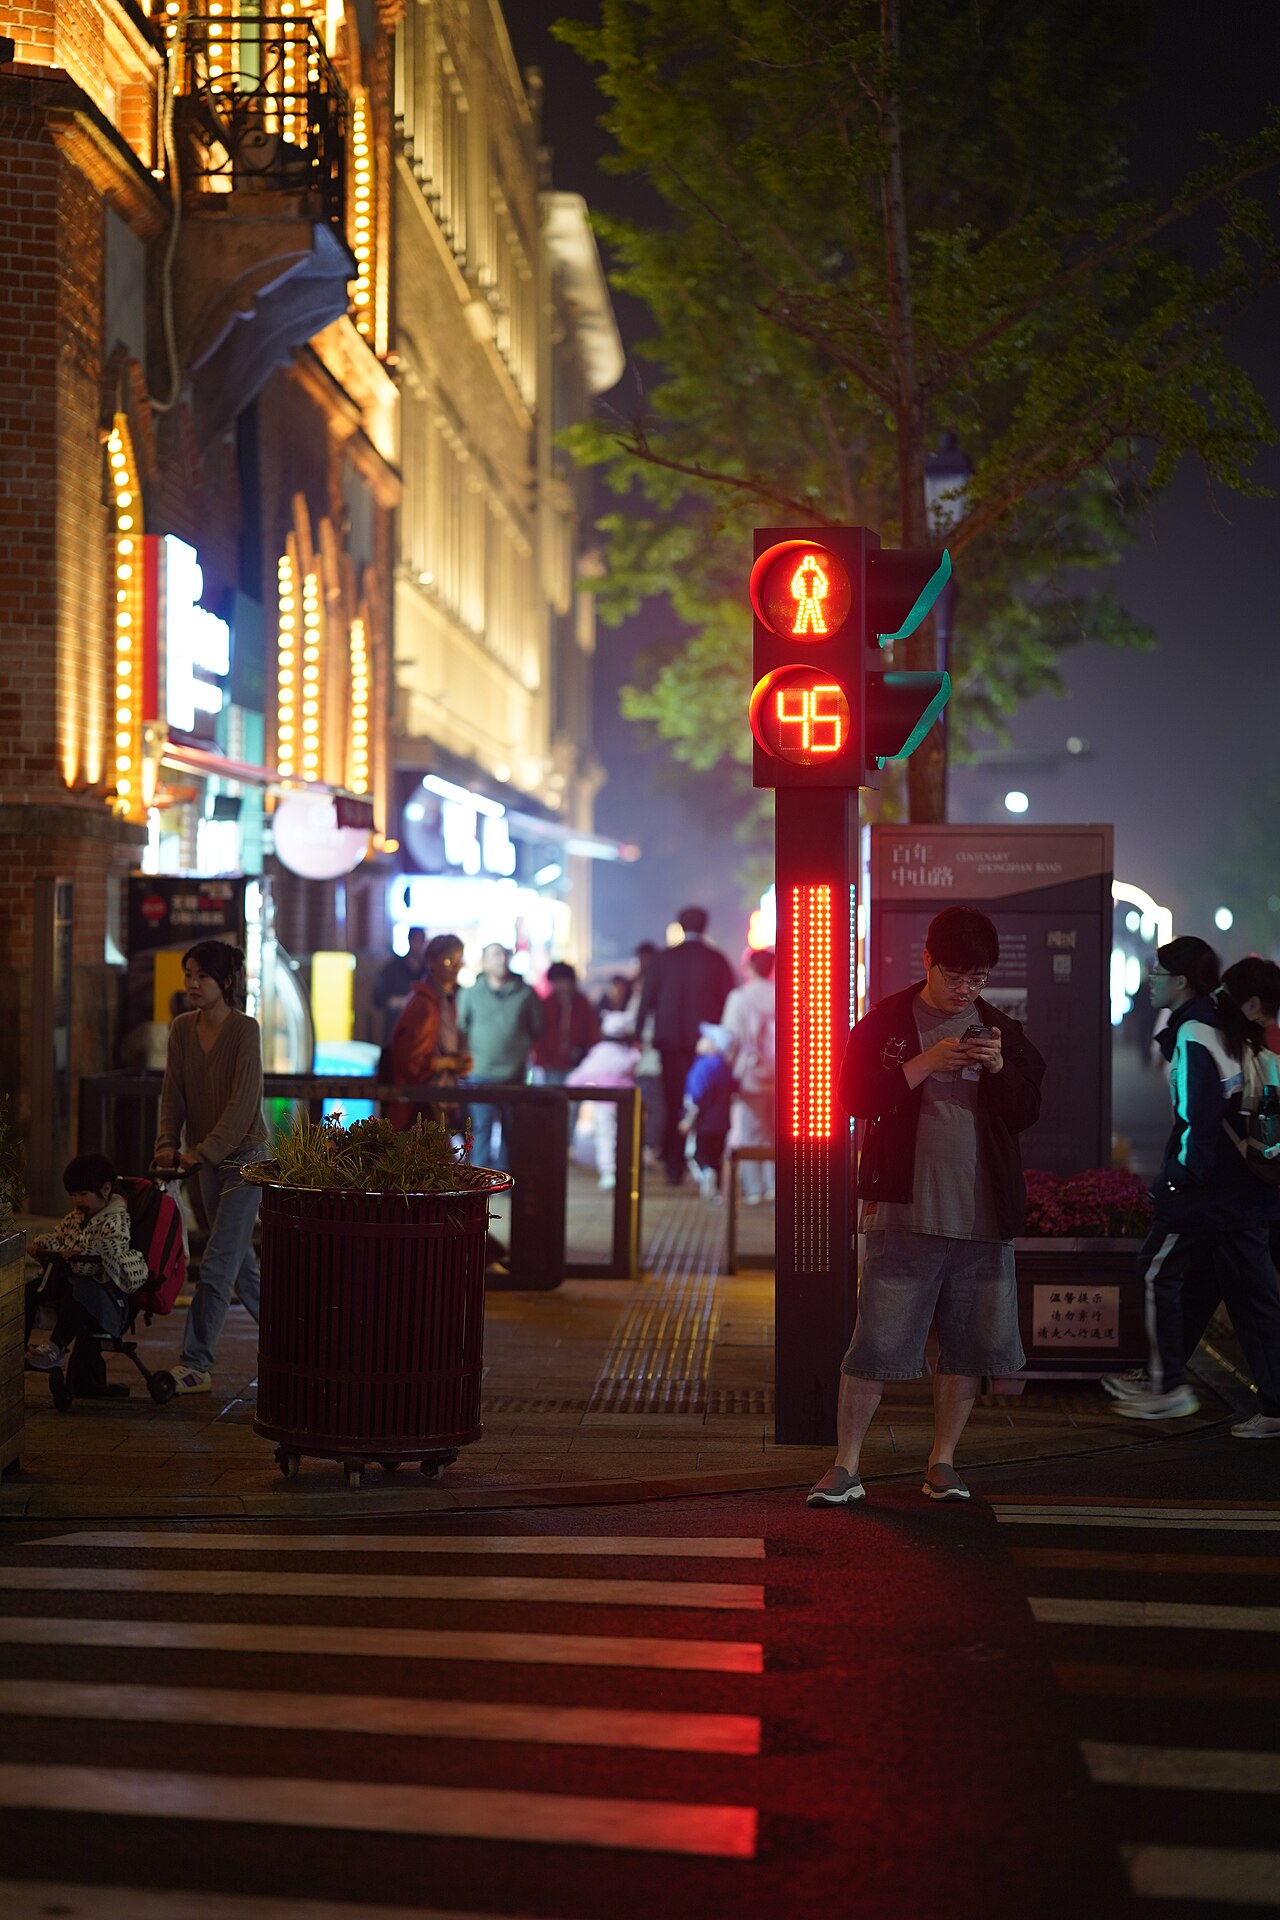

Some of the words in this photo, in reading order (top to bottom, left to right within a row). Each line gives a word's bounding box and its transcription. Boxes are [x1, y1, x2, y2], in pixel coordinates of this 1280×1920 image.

[777, 685, 841, 752] 45
[891, 866, 954, 888] 中山路
[1049, 1291, 1103, 1304] 温馨提示
